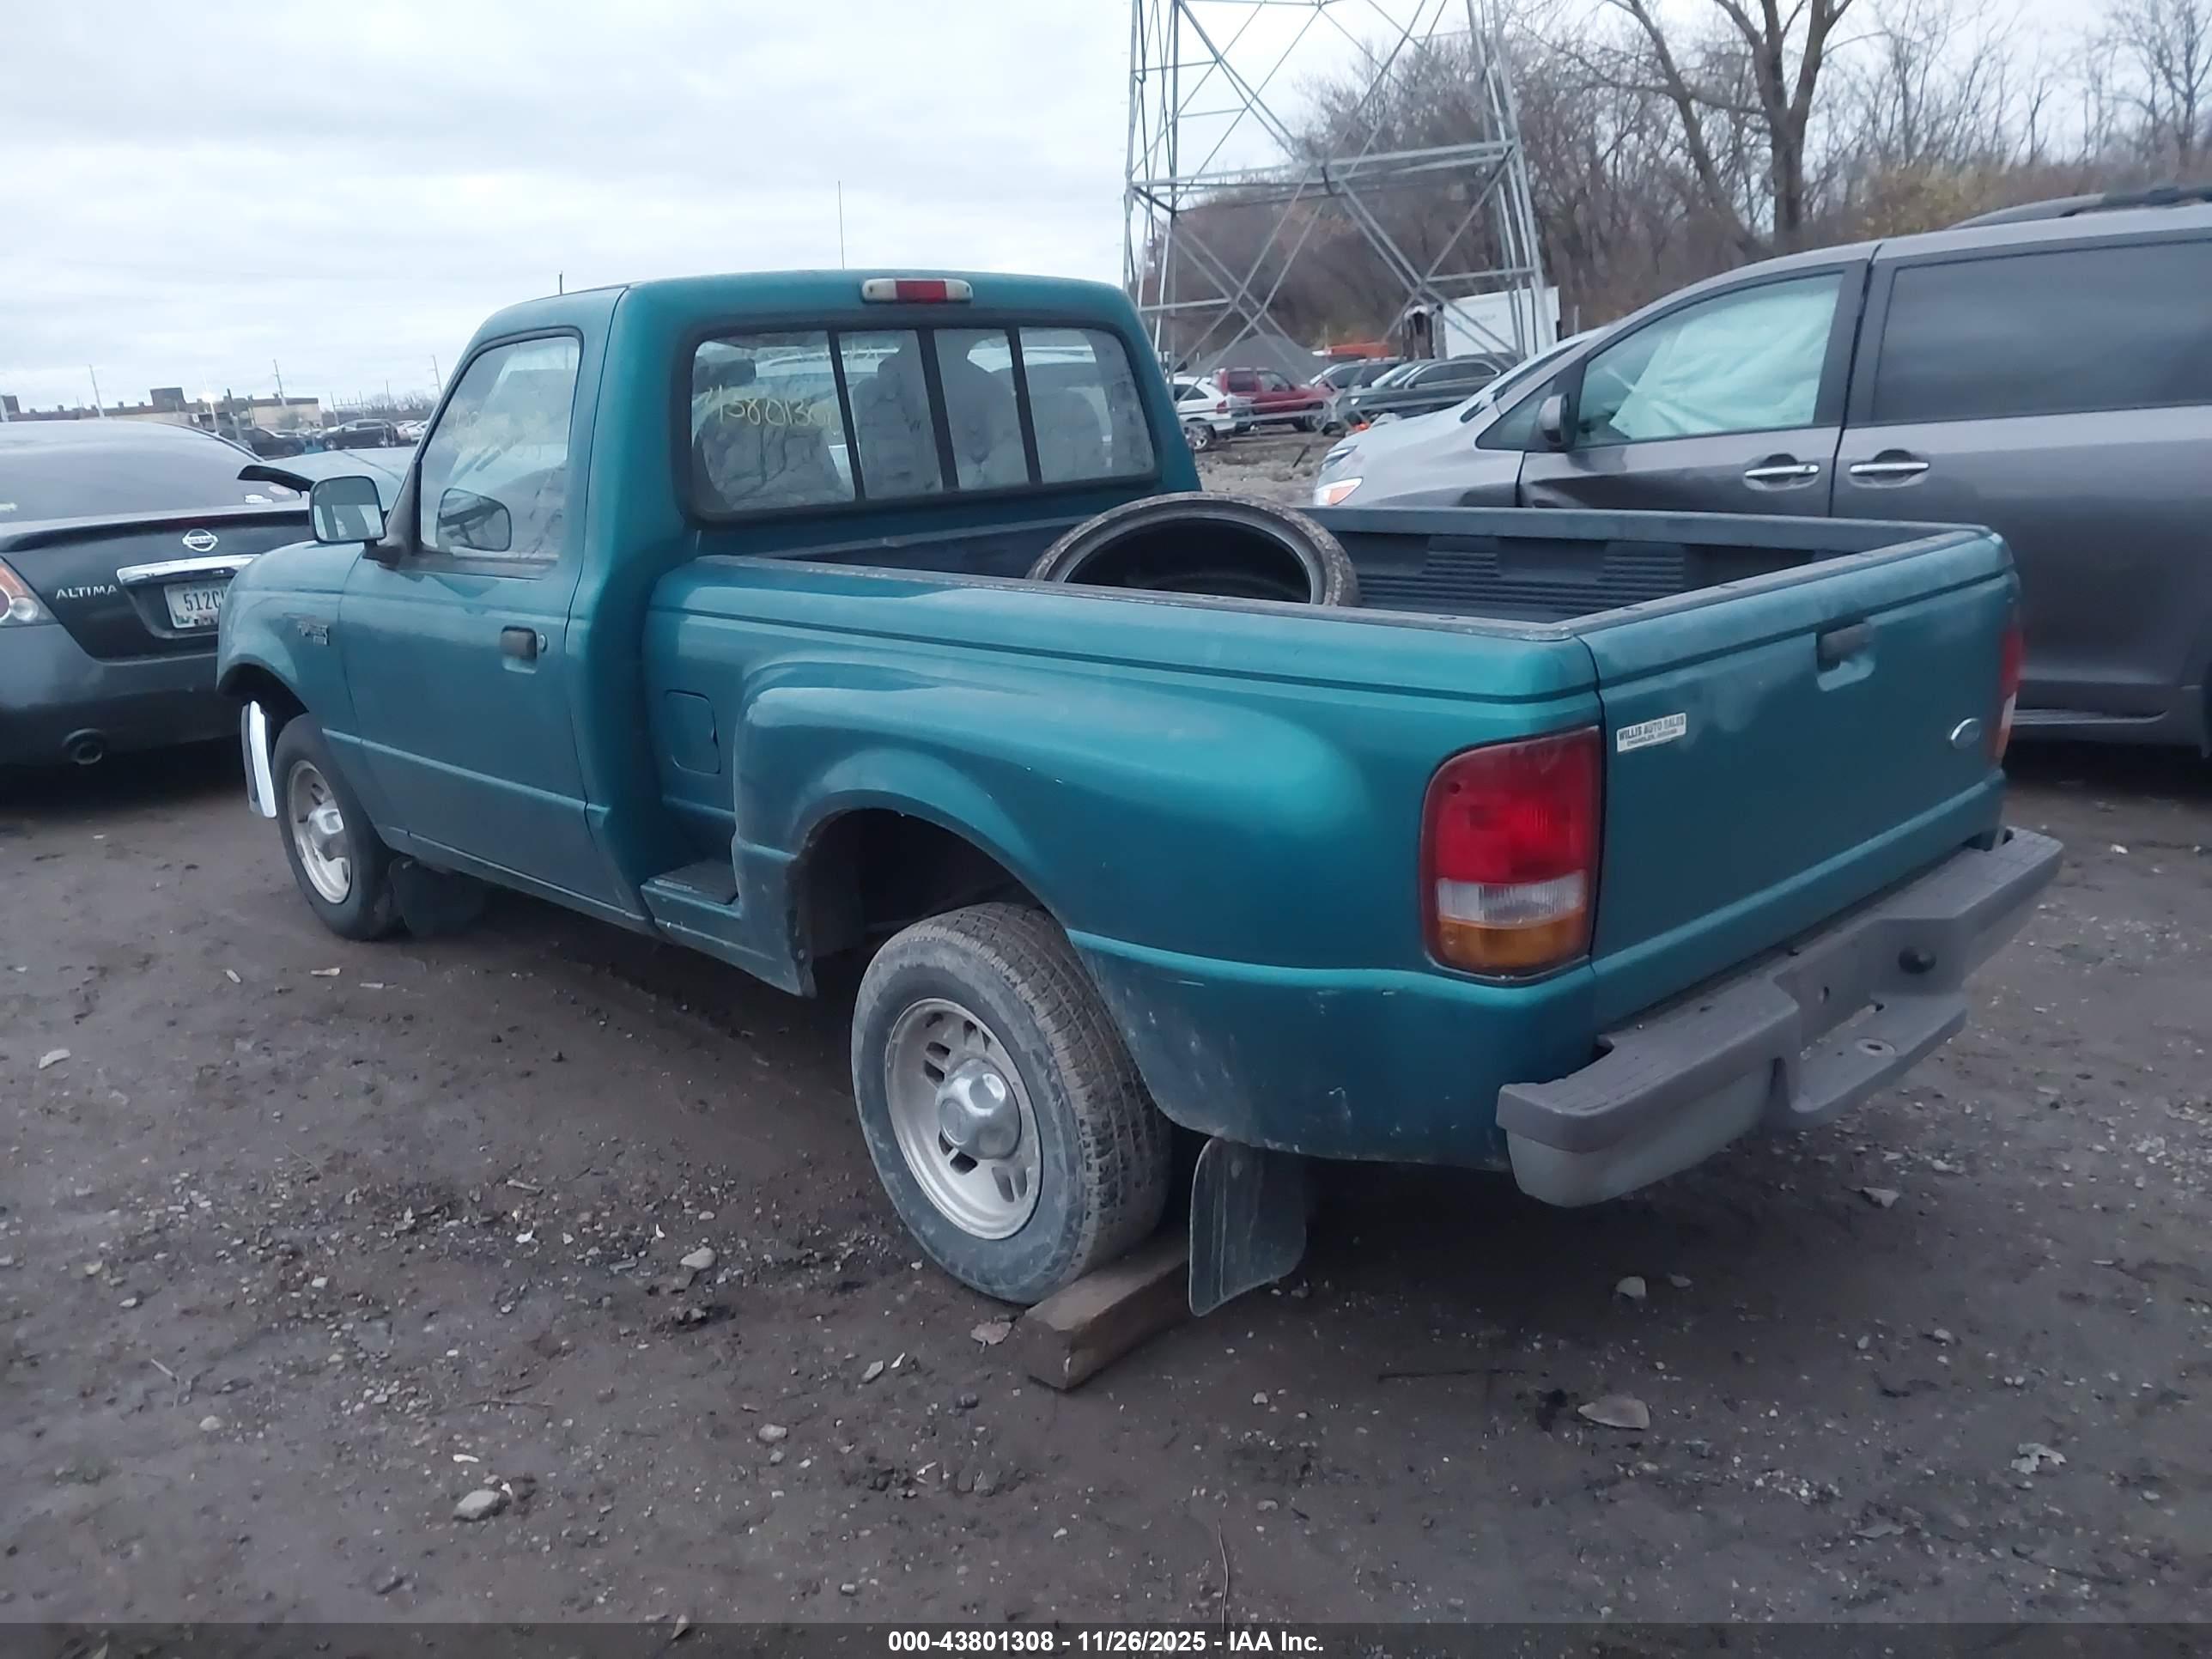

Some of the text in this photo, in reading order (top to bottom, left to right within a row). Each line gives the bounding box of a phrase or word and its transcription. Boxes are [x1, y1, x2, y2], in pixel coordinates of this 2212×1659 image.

[56, 584, 118, 599] ALTIMA
[1619, 726, 1642, 742] WILLIS
[1644, 720, 1662, 735] AUTO
